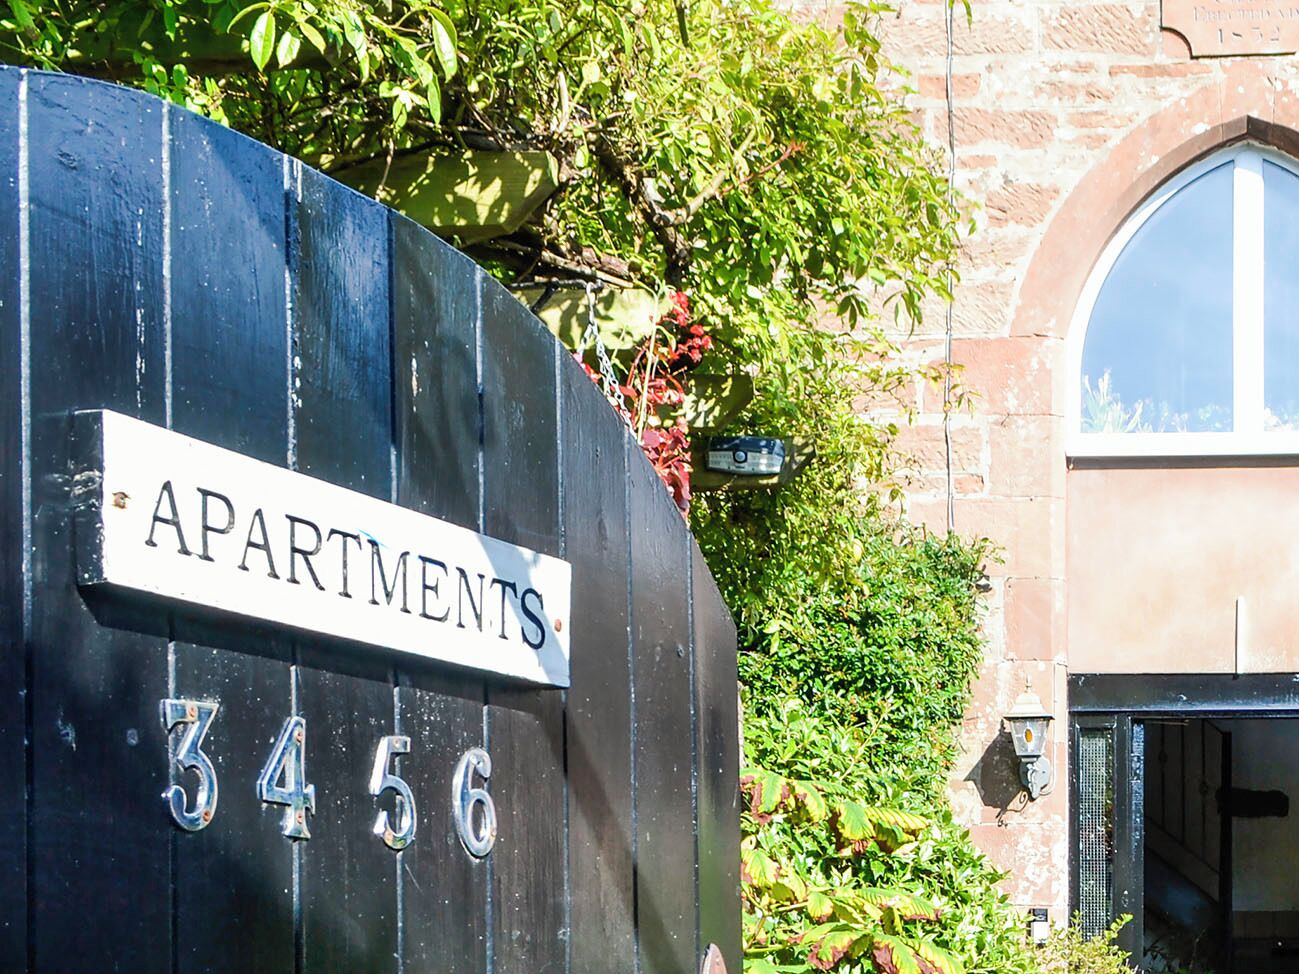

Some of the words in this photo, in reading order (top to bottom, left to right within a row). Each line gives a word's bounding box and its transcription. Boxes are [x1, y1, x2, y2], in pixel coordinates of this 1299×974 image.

[144, 479, 547, 651] APARTMENTS
[160, 698, 219, 832] 3
[256, 715, 315, 840] 4
[368, 735, 418, 850] 5
[452, 746, 498, 863] 6
